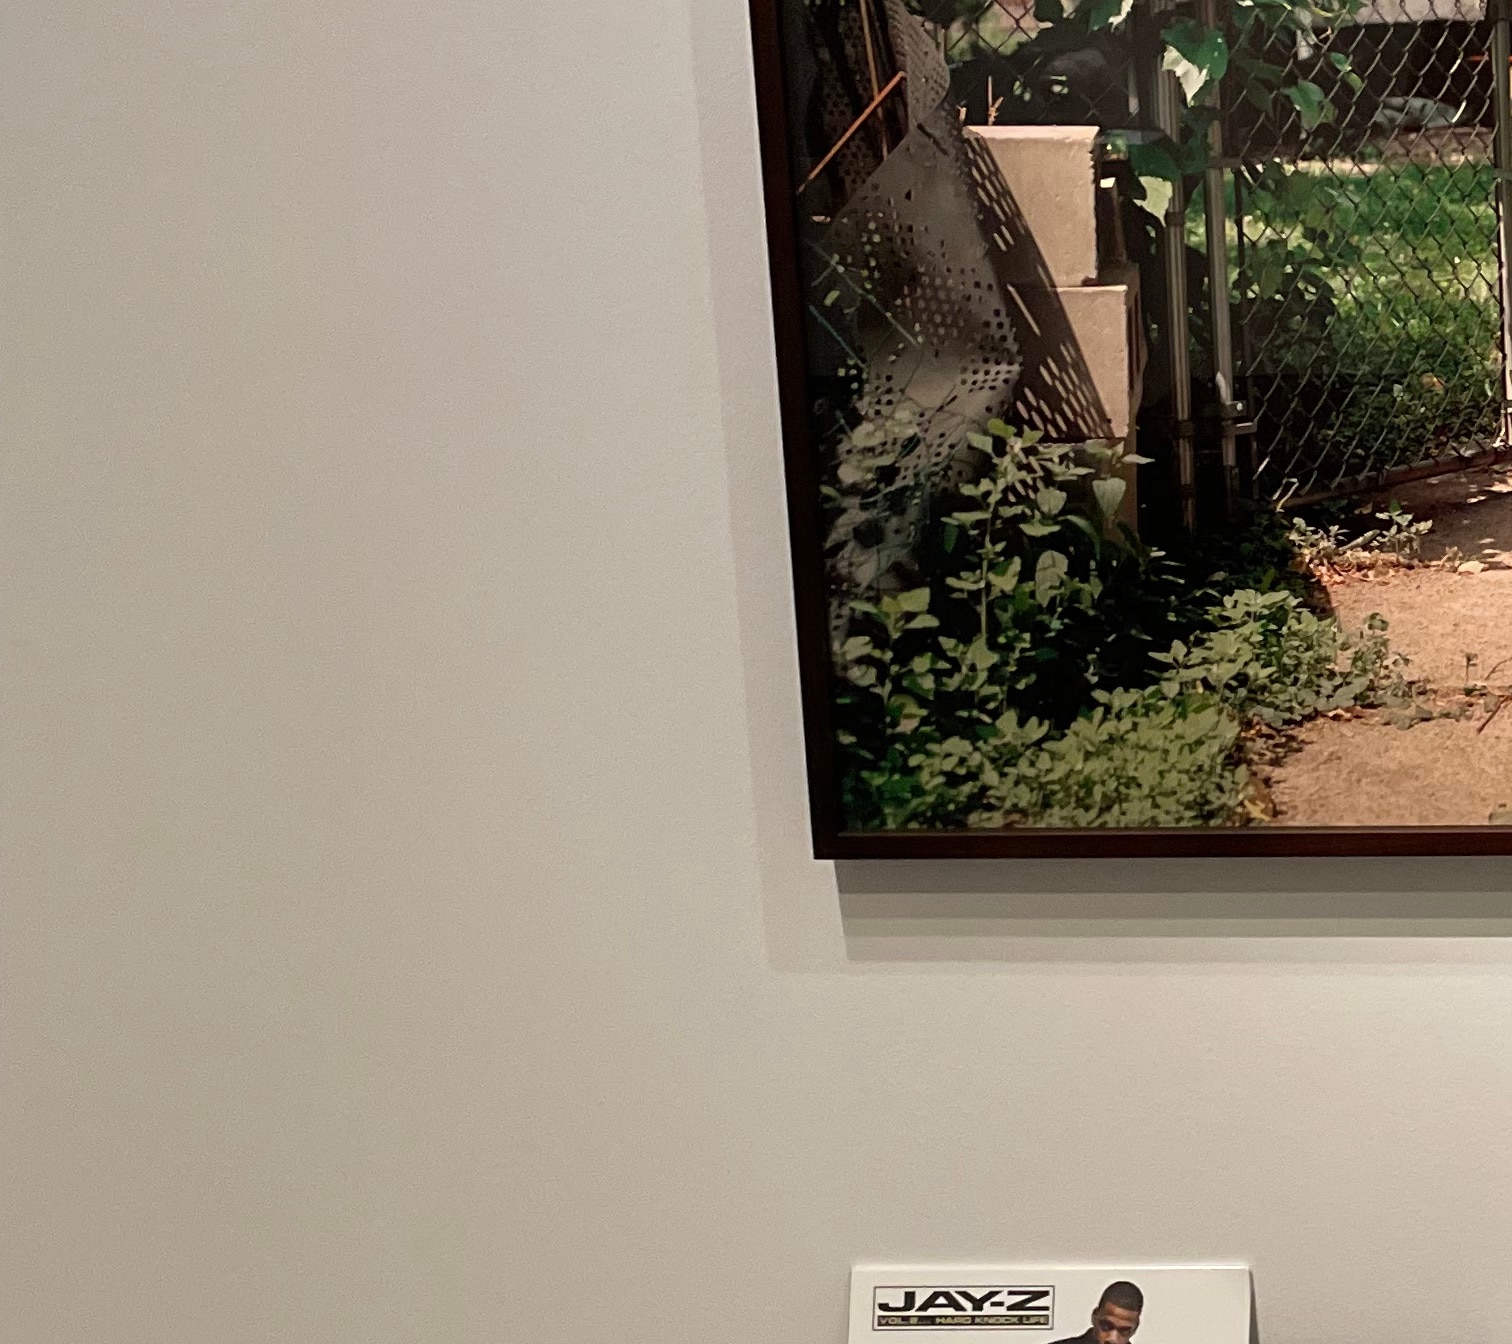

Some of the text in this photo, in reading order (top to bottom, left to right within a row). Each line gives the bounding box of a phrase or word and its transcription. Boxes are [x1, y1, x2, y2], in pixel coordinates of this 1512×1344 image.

[877, 1290, 1051, 1312] JAY-Z
[935, 1317, 972, 1325] HARD
[974, 1317, 1019, 1325] KNOCK
[1022, 1317, 1048, 1325] LIFE
